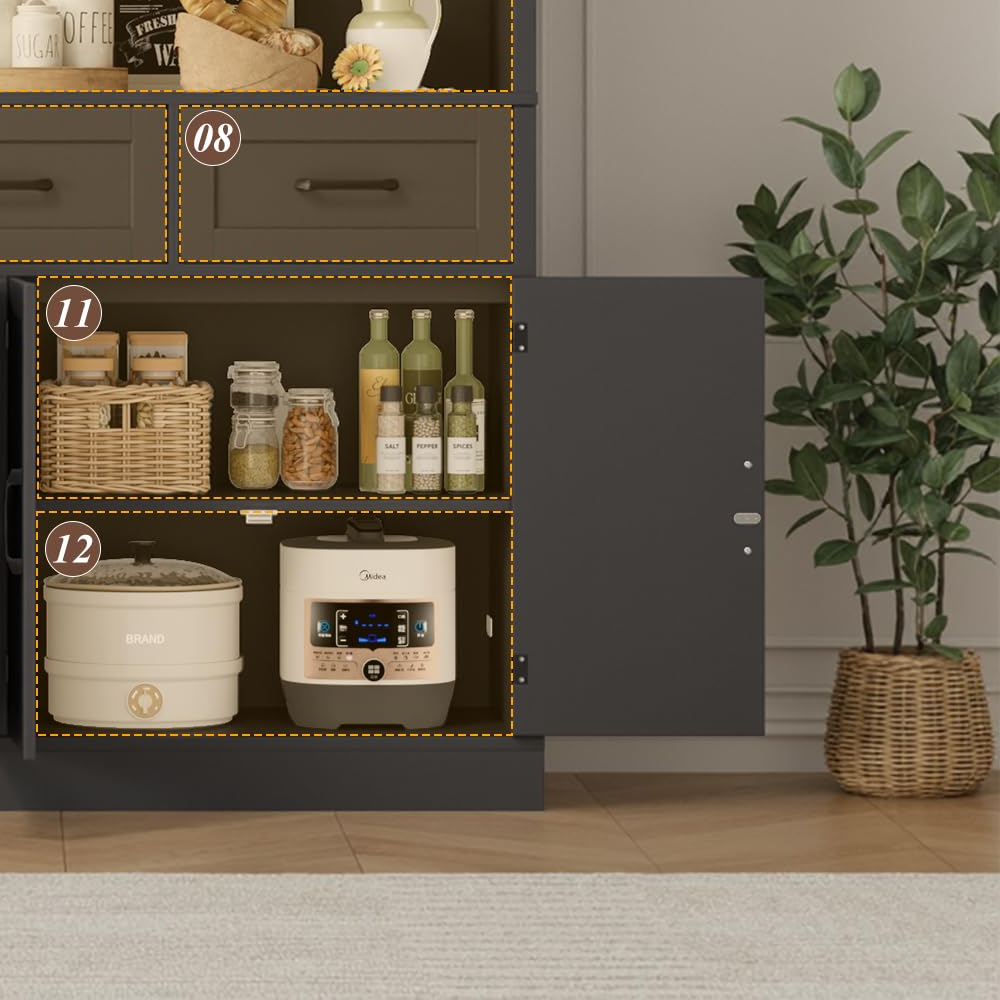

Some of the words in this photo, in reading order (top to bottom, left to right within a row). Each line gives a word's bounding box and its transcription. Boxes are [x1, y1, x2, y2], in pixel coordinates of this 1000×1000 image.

[56, 11, 113, 45] OFFEE
[15, 33, 60, 60] SUGAR
[359, 569, 387, 581] Midea
[125, 633, 165, 645] BRAND
